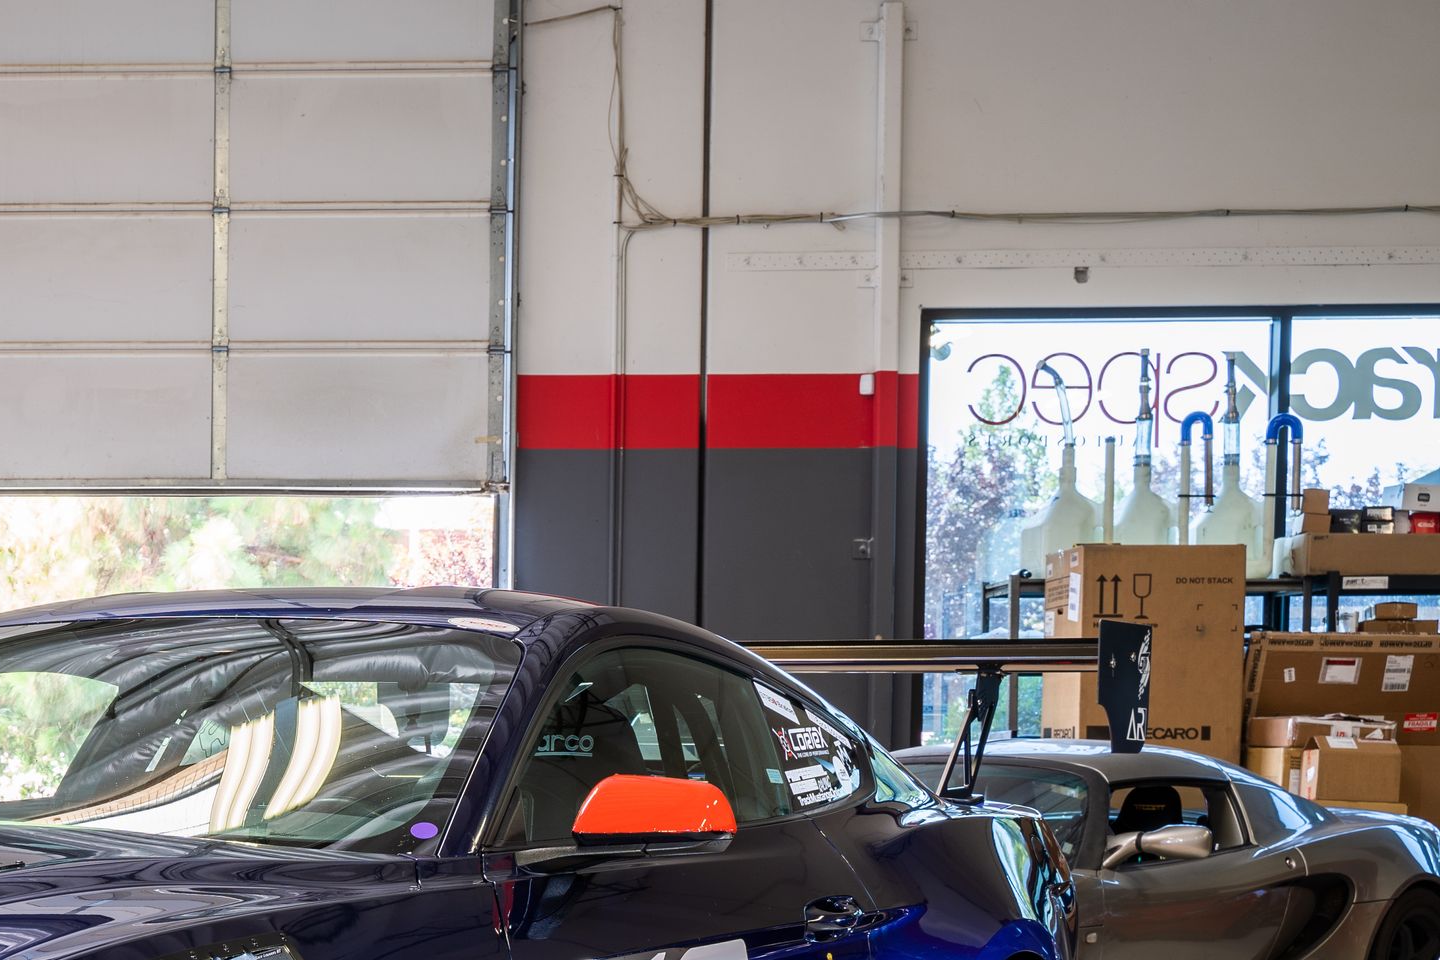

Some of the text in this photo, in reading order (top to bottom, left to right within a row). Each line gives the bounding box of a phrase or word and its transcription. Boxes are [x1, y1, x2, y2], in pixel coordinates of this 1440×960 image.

[1175, 576, 1234, 585] DO NOT STACK
[1145, 727, 1199, 741] ECARO
